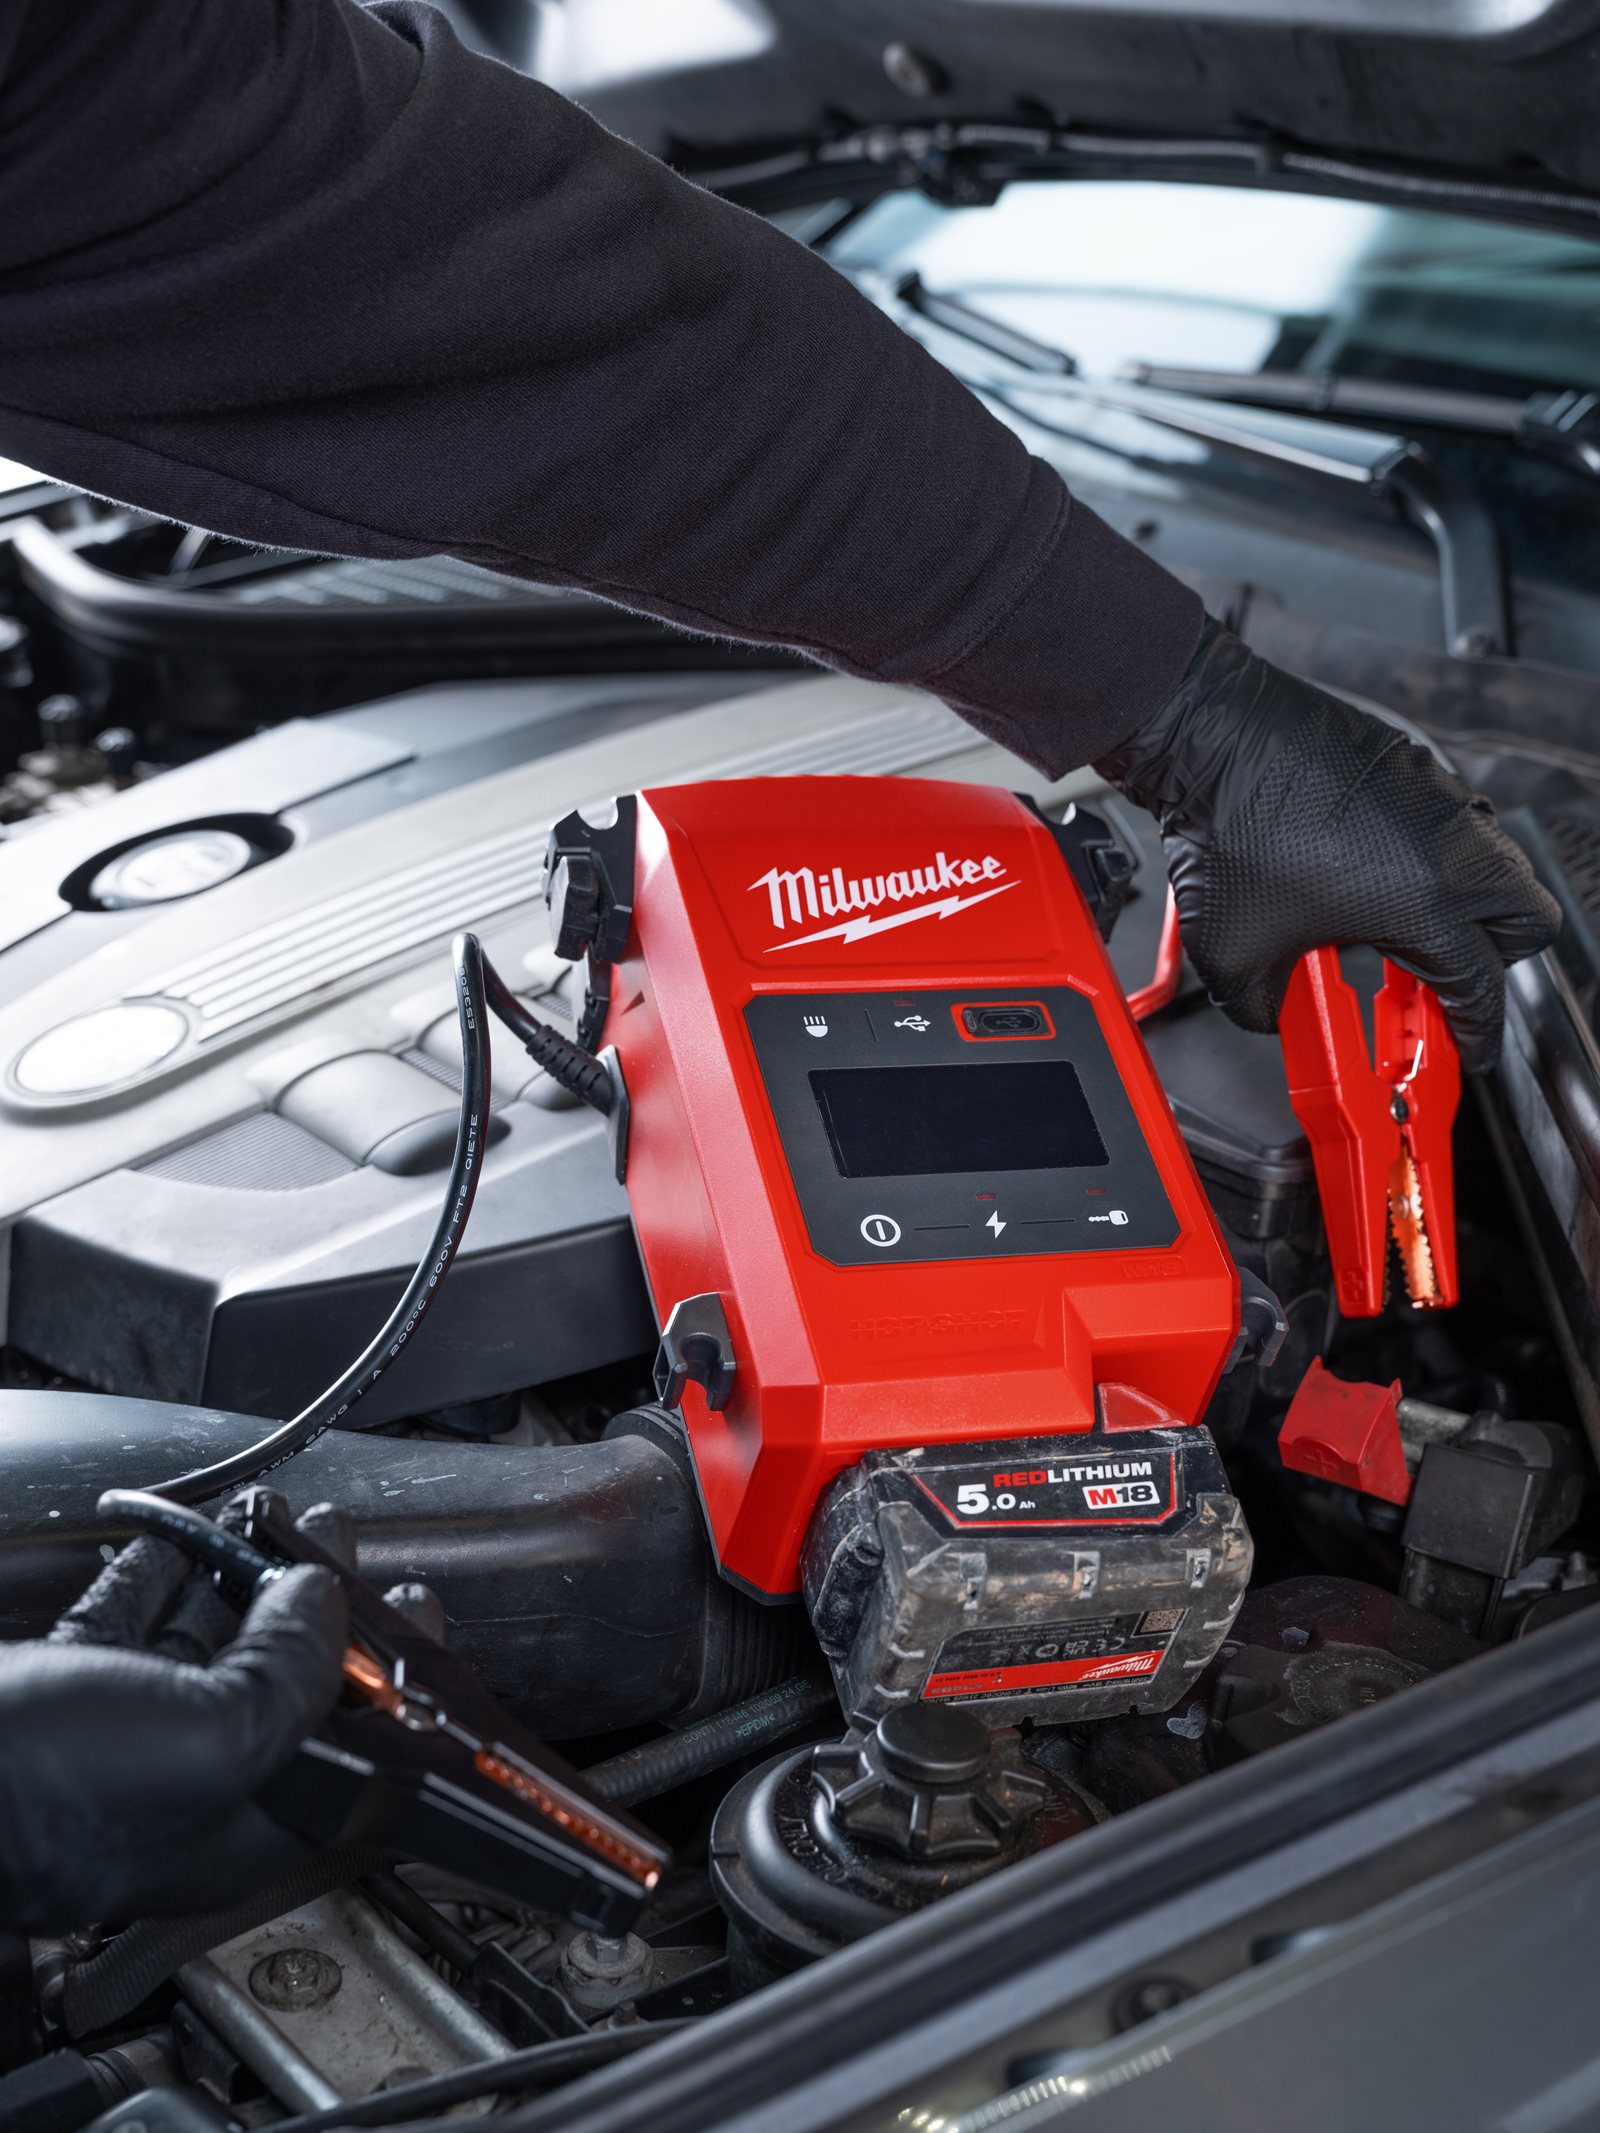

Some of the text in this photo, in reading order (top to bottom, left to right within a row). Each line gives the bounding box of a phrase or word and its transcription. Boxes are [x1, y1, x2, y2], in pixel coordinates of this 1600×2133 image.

[747, 852, 1007, 930] Milwaukee
[258, 1450, 295, 1478] AWM
[372, 1369, 382, 1381] A
[429, 1235, 454, 1288] 600V
[993, 1461, 1152, 1489] REDLITHIUM
[956, 1483, 1036, 1515] 5.0 Ah
[1087, 1484, 1154, 1507] M18
